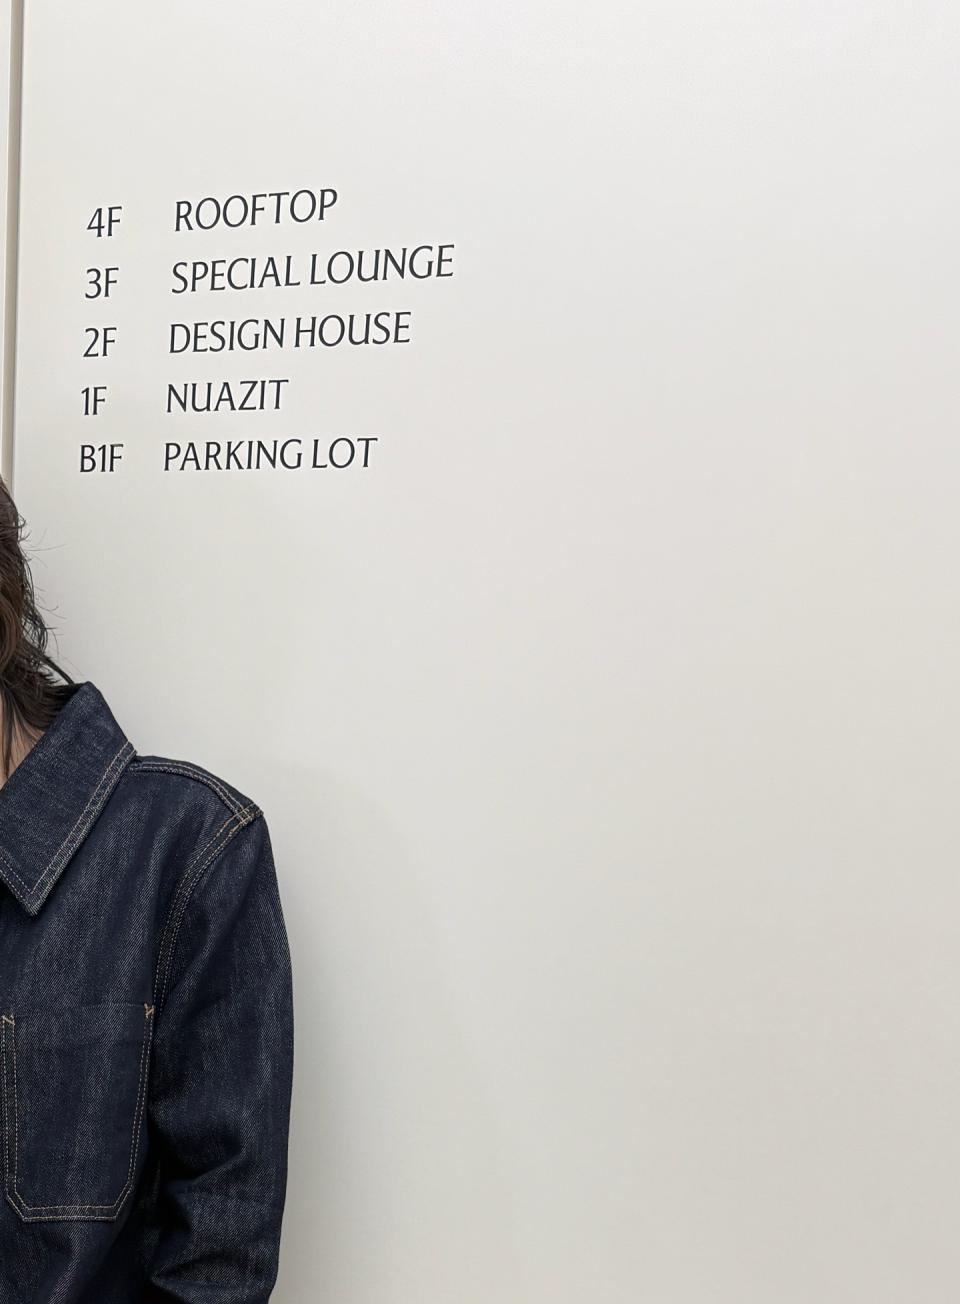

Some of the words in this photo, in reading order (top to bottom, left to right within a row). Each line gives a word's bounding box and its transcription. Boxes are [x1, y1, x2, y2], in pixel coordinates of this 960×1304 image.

[87, 206, 122, 237] 4F
[175, 188, 338, 231] ROOFTOP
[84, 267, 119, 298] 3F
[171, 255, 301, 293] SPECIAL
[309, 244, 455, 285] LOUNGE
[83, 327, 117, 357] 2F
[169, 318, 286, 354] DESIGN
[294, 311, 412, 348] HOUSE
[81, 386, 107, 416] 1F
[166, 379, 289, 413] NUAZIT
[79, 444, 124, 473] B1F
[164, 439, 303, 471] PARKING
[311, 437, 379, 469] LOT
